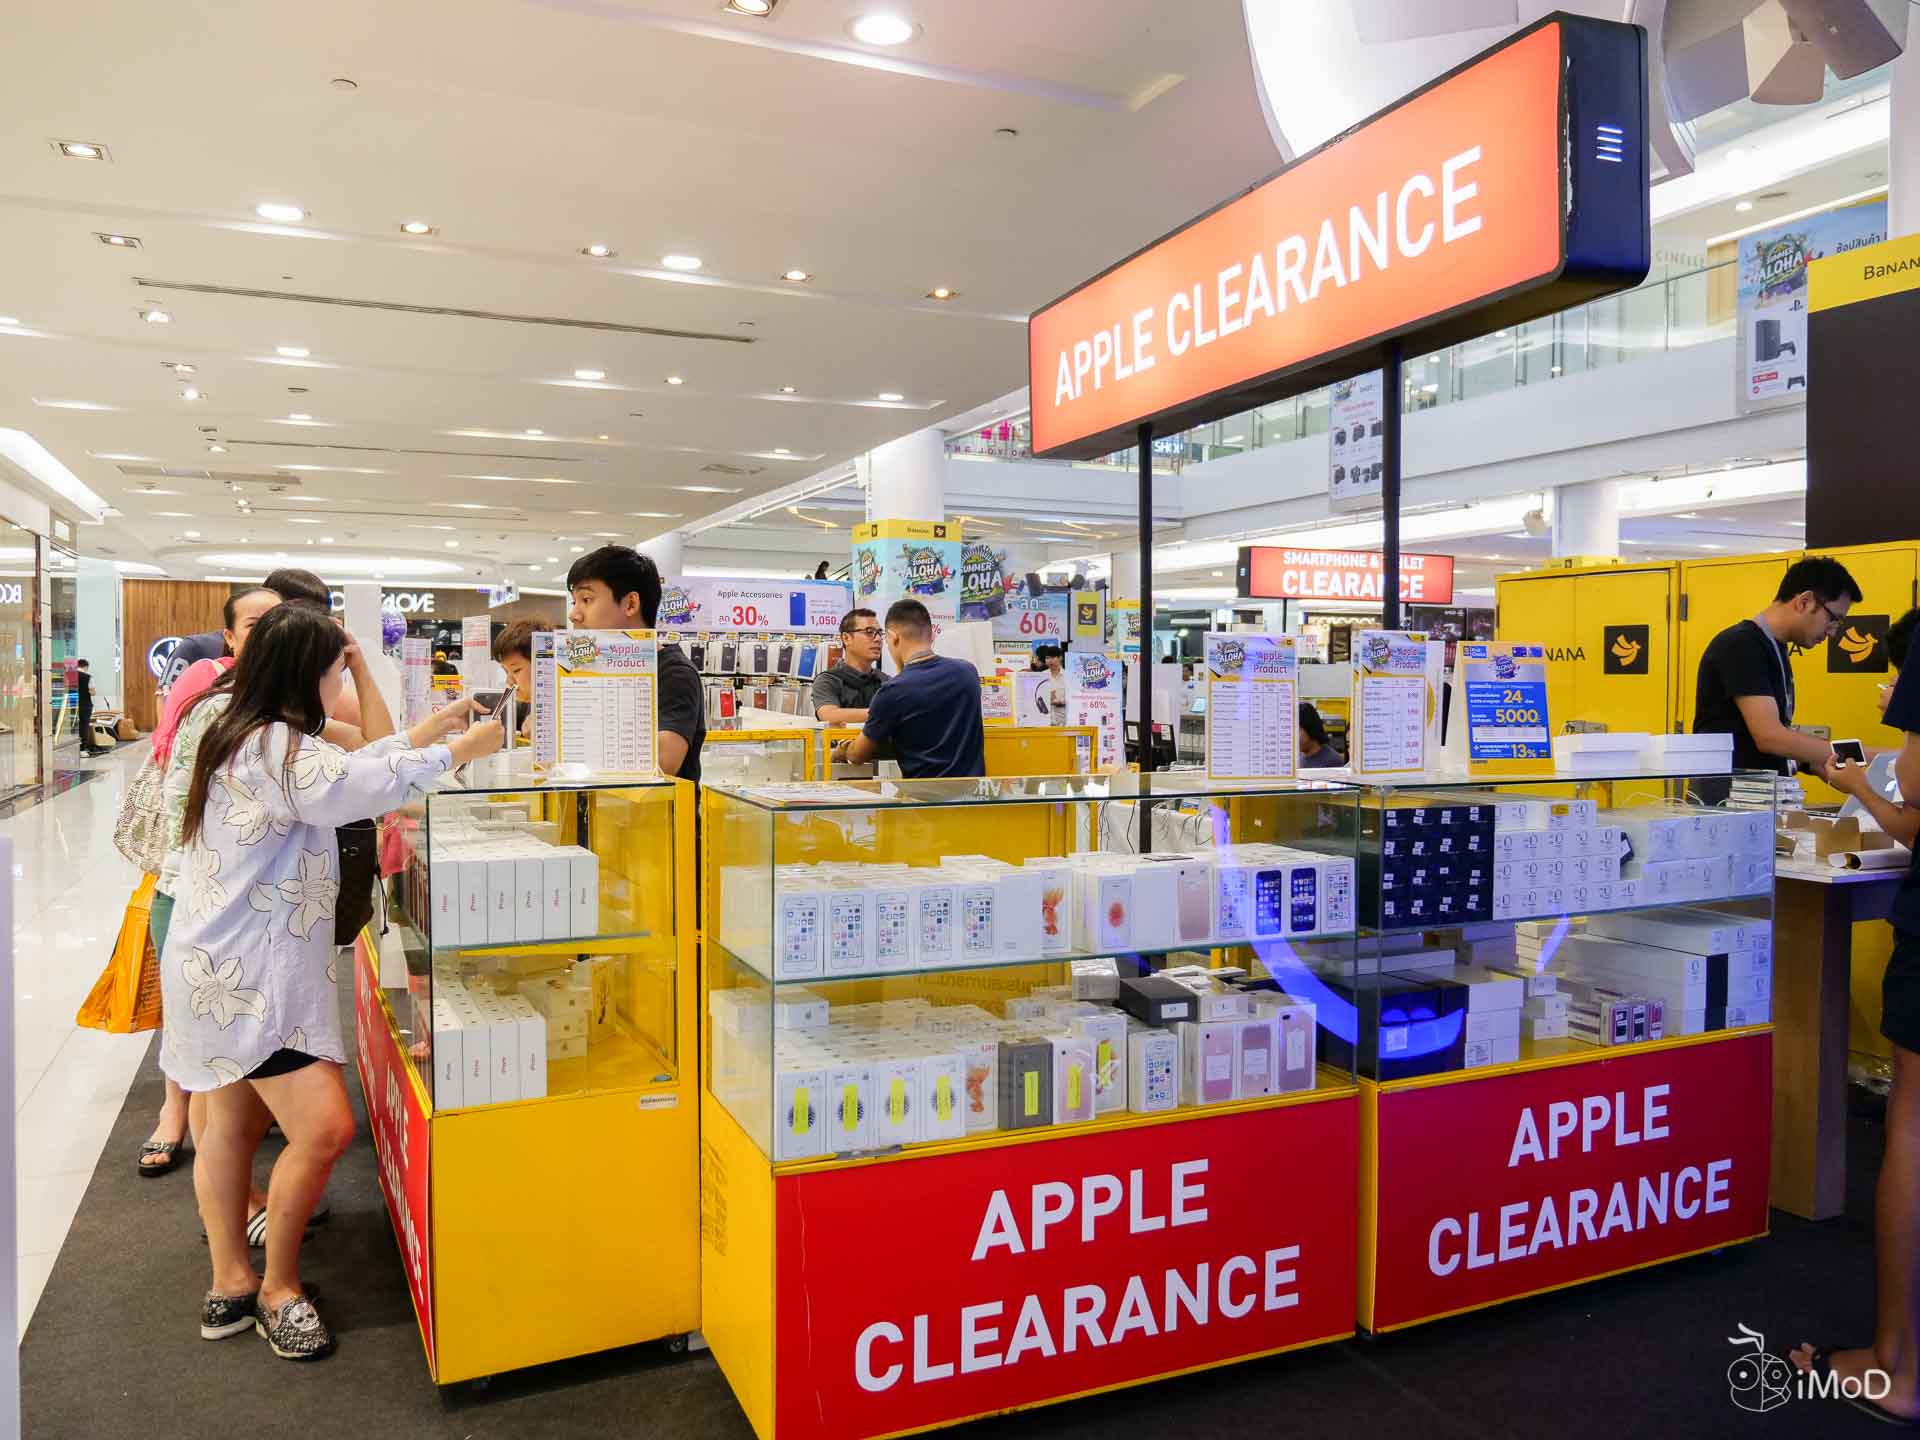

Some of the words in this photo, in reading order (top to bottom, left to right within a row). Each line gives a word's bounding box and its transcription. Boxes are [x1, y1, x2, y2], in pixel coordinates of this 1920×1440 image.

[1055, 307, 1157, 407] APPLE
[1166, 145, 1483, 358] CLEARANCE
[1283, 551, 1369, 568] SMARTPHONE
[1371, 556, 1380, 568] &
[906, 563, 942, 577] ALOHA
[717, 590, 738, 599] Apple
[740, 591, 783, 599] Accessories
[732, 606, 768, 626] 30%
[1019, 612, 1060, 635] 60%
[568, 644, 595, 657] ALOHA
[609, 644, 641, 655] Apple
[607, 658, 646, 668] Product
[1253, 664, 1288, 674] Product
[1503, 689, 1523, 703] 24
[1511, 743, 1536, 758] 13%
[1507, 1084, 1671, 1167] APPLE
[971, 1158, 1209, 1261] APPLE
[1428, 1159, 1731, 1276] CLEARANCE
[855, 1245, 1300, 1392] CLEARANCE
